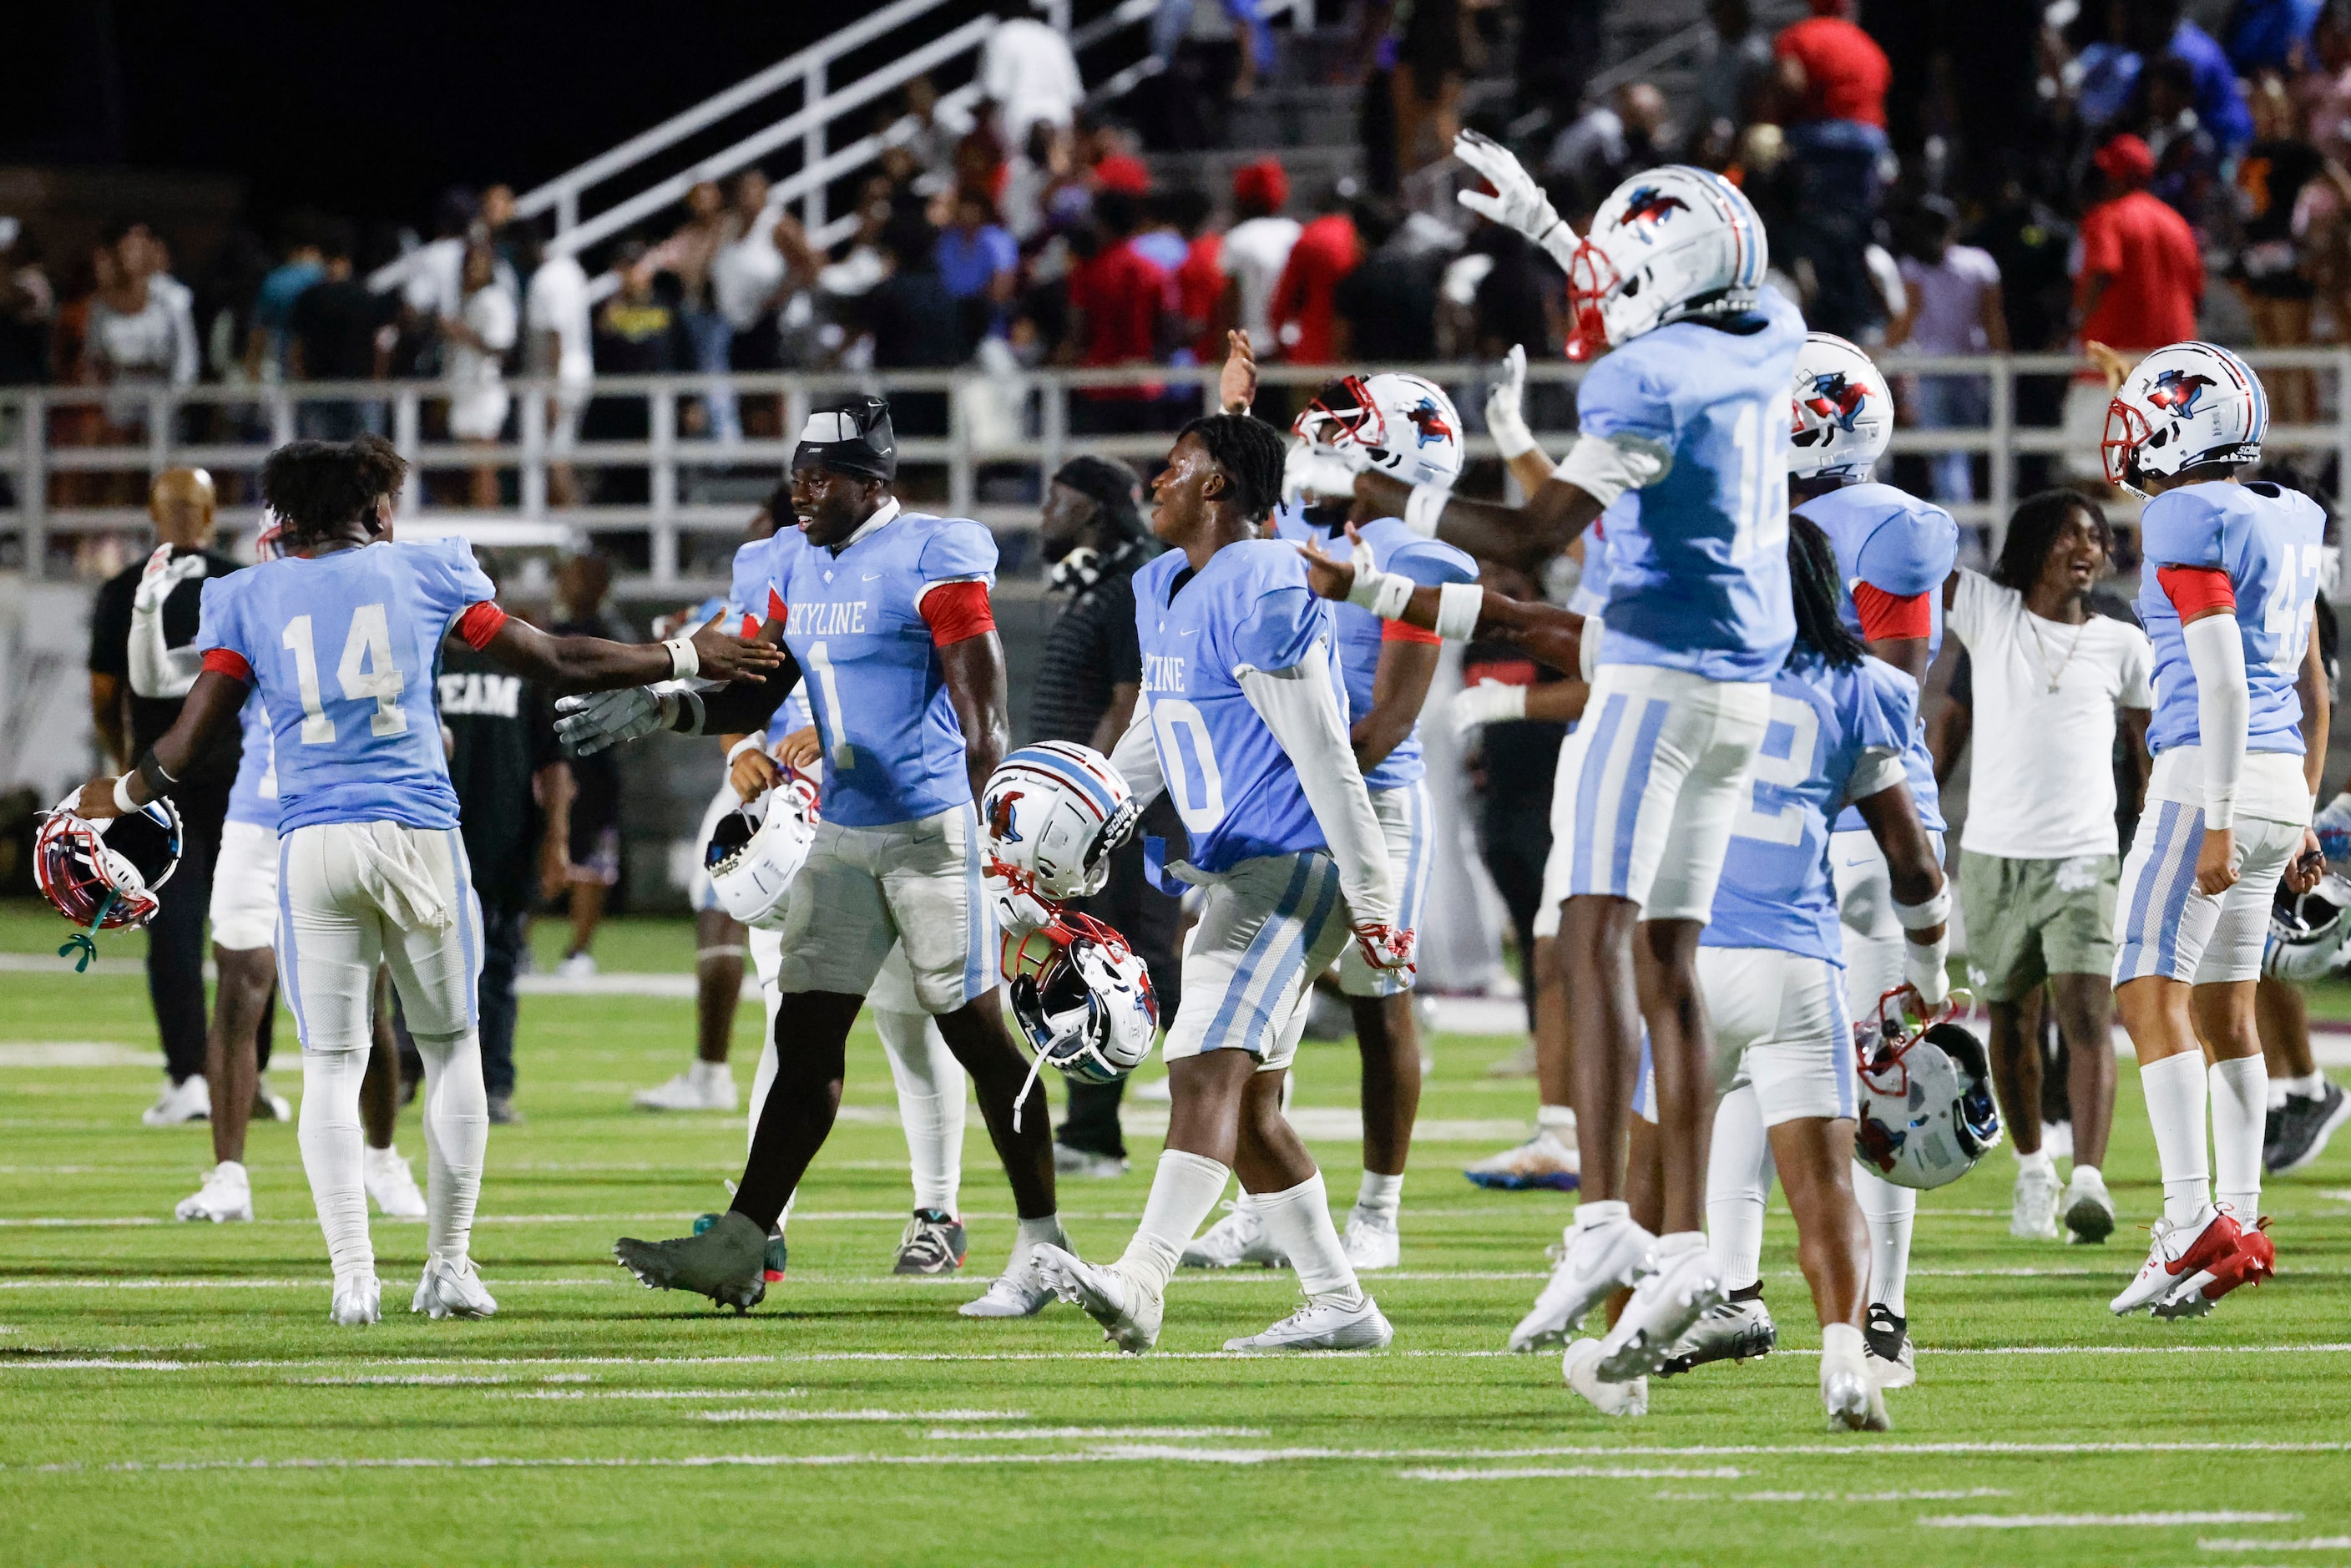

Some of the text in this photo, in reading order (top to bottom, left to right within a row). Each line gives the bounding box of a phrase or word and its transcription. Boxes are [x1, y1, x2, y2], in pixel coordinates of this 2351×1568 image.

[2126, 486, 2146, 500] schutt
[282, 603, 407, 744] 14
[786, 601, 867, 635] SKYLINE
[2264, 544, 2322, 675] 42
[437, 673, 521, 718] EAM
[807, 641, 855, 769] 1
[1152, 699, 1225, 833] 0
